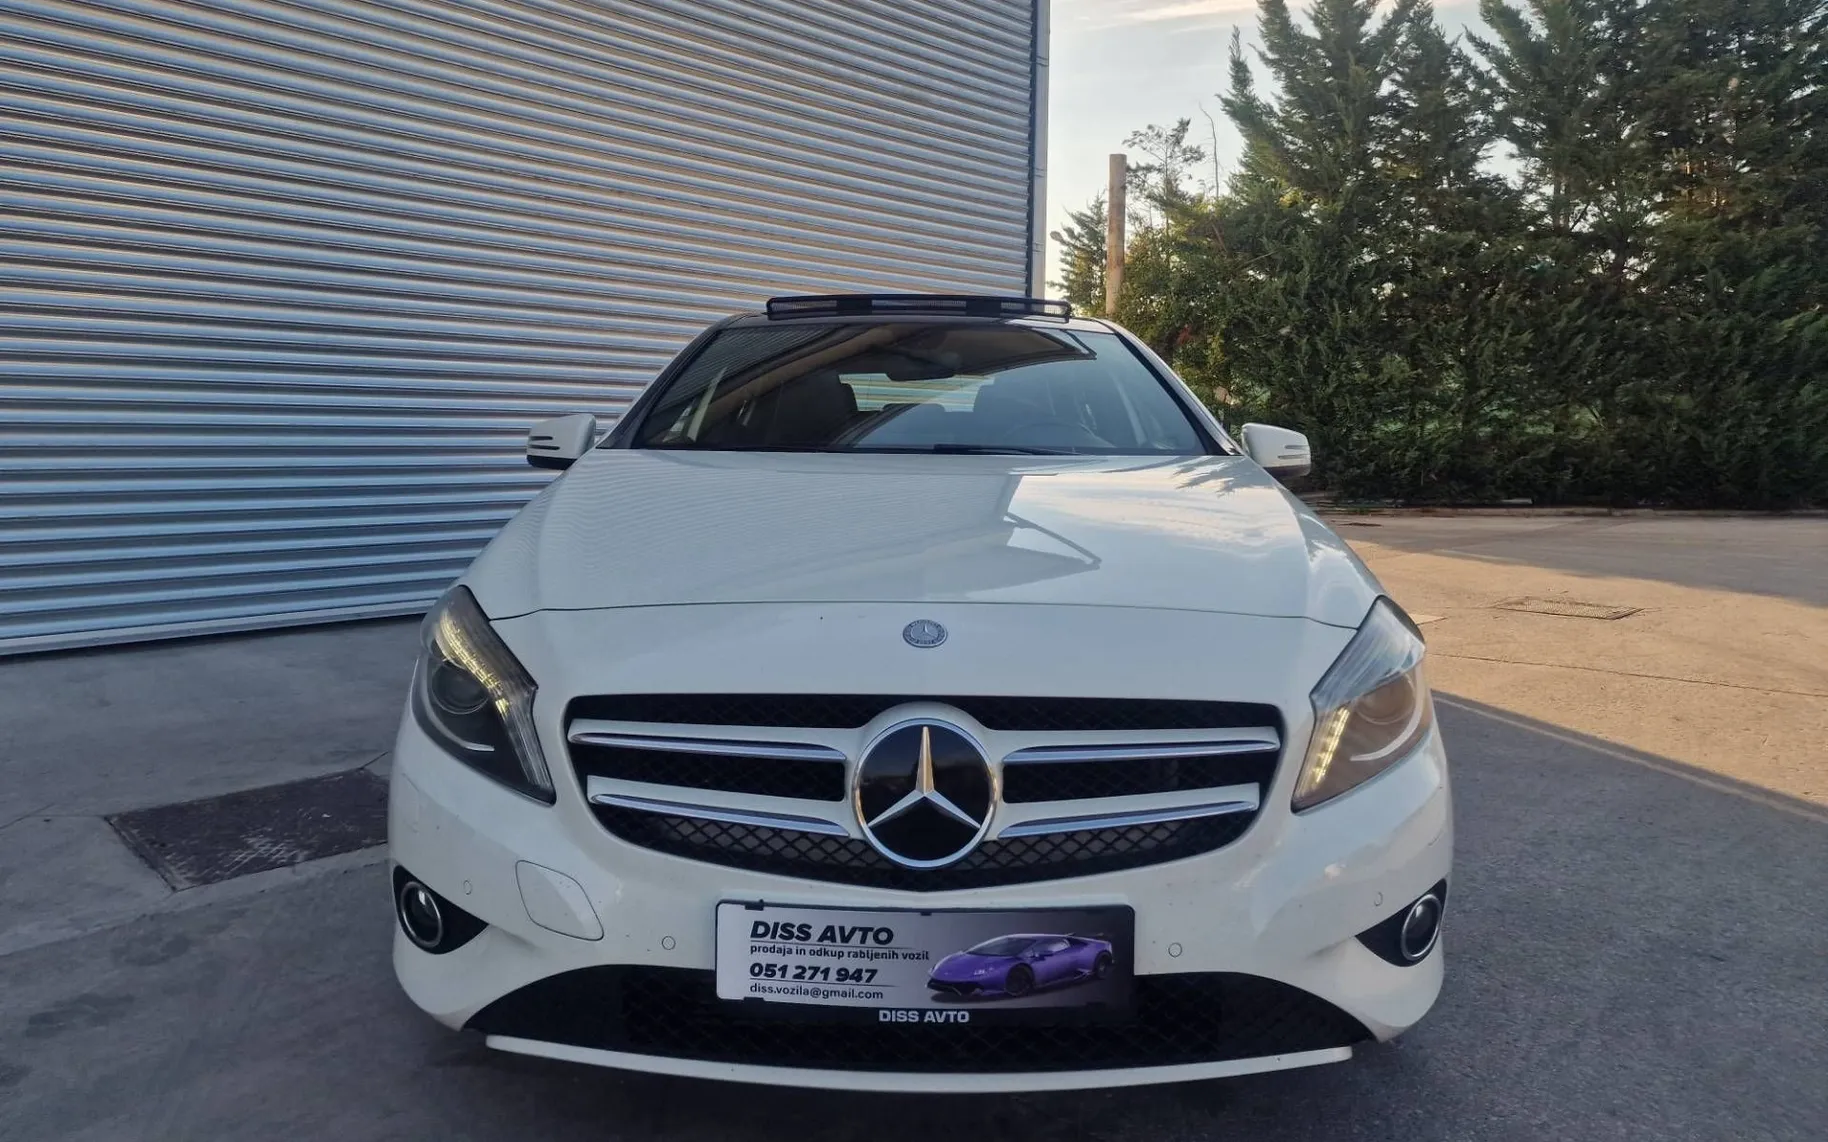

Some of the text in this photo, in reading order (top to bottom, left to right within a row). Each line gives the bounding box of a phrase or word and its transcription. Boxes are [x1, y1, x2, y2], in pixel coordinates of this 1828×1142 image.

[750, 920, 894, 945] DISS AVTO
[750, 944, 930, 961] prodaja in odkup rabljenih vozil
[750, 962, 878, 983] 051 271 947
[750, 983, 884, 1000] diss.vozila@gmail.com
[878, 1010, 970, 1023] DISS AVTO
